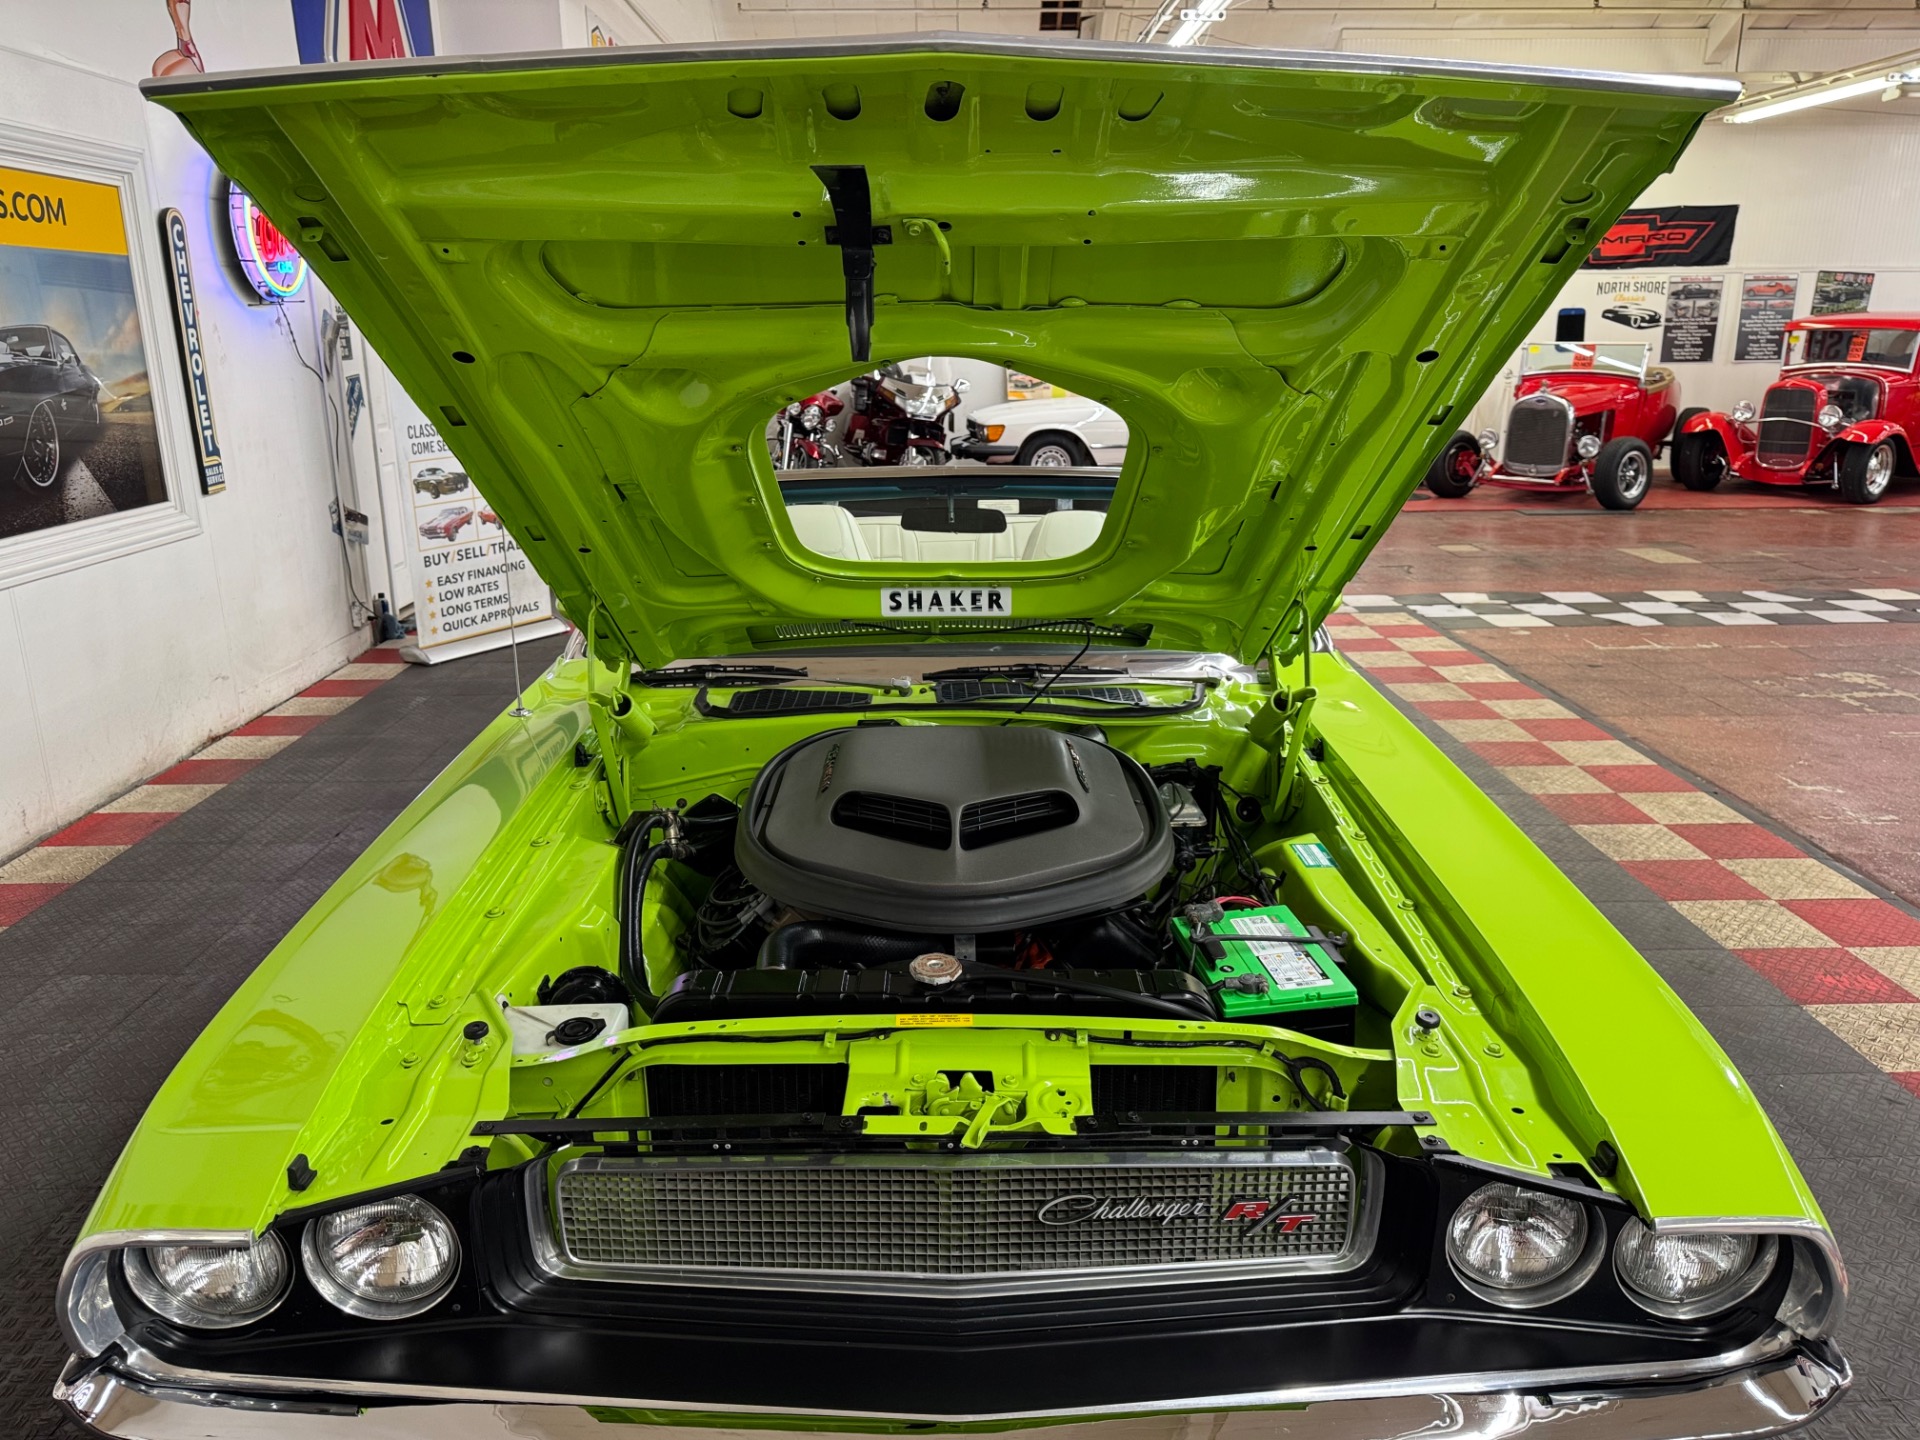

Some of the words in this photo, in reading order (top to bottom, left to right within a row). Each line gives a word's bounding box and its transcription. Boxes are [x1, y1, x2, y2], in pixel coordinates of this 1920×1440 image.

[1601, 232, 1686, 245] MARO
[1597, 281, 1630, 296] NORTH
[1633, 281, 1667, 295] SHORE
[173, 223, 214, 452] CHEVROLET
[407, 424, 438, 439] CLASS
[411, 441, 435, 455] COME
[436, 440, 449, 452] SE
[205, 465, 219, 476] SALES
[206, 473, 225, 485] SERVICE
[437, 572, 465, 587] EASY
[467, 560, 526, 580] FINANCING
[439, 587, 465, 602] LOW
[467, 580, 499, 596] RATES
[889, 590, 1004, 612] SHAKER
[441, 601, 472, 617] LONG
[474, 593, 509, 609] TERMS
[443, 615, 478, 632] QUICK
[480, 601, 540, 624] APPROVALS
[1038, 1194, 1205, 1226] Challenger
[1224, 1196, 1316, 1236] R/T
